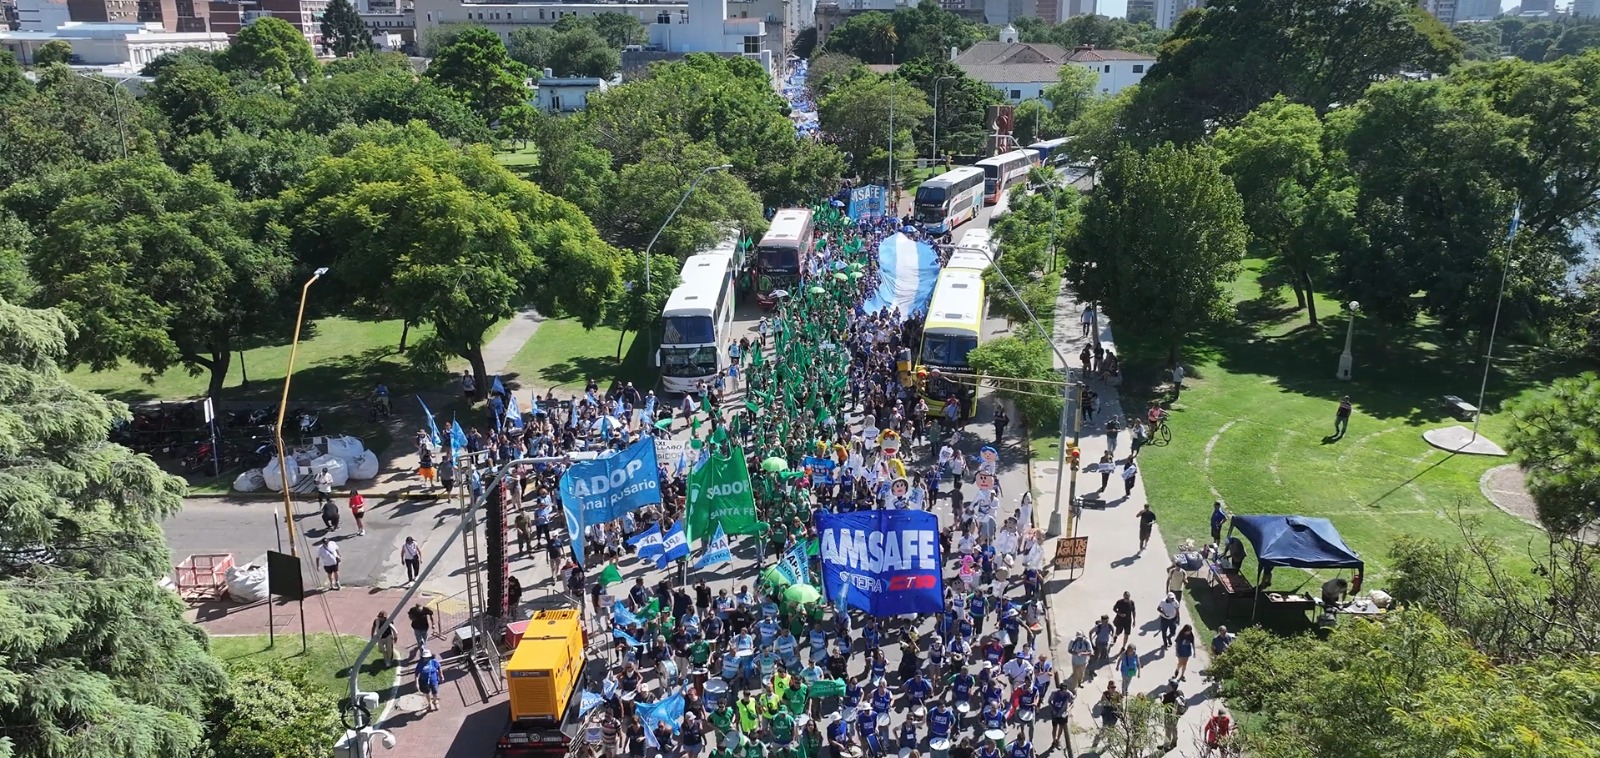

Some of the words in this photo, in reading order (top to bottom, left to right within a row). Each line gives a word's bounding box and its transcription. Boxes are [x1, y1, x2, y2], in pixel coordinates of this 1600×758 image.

[851, 187, 880, 202] MSAFE
[574, 459, 643, 498] ADOP
[710, 508, 740, 520] SANTA
[821, 528, 935, 574] AMSAFE
